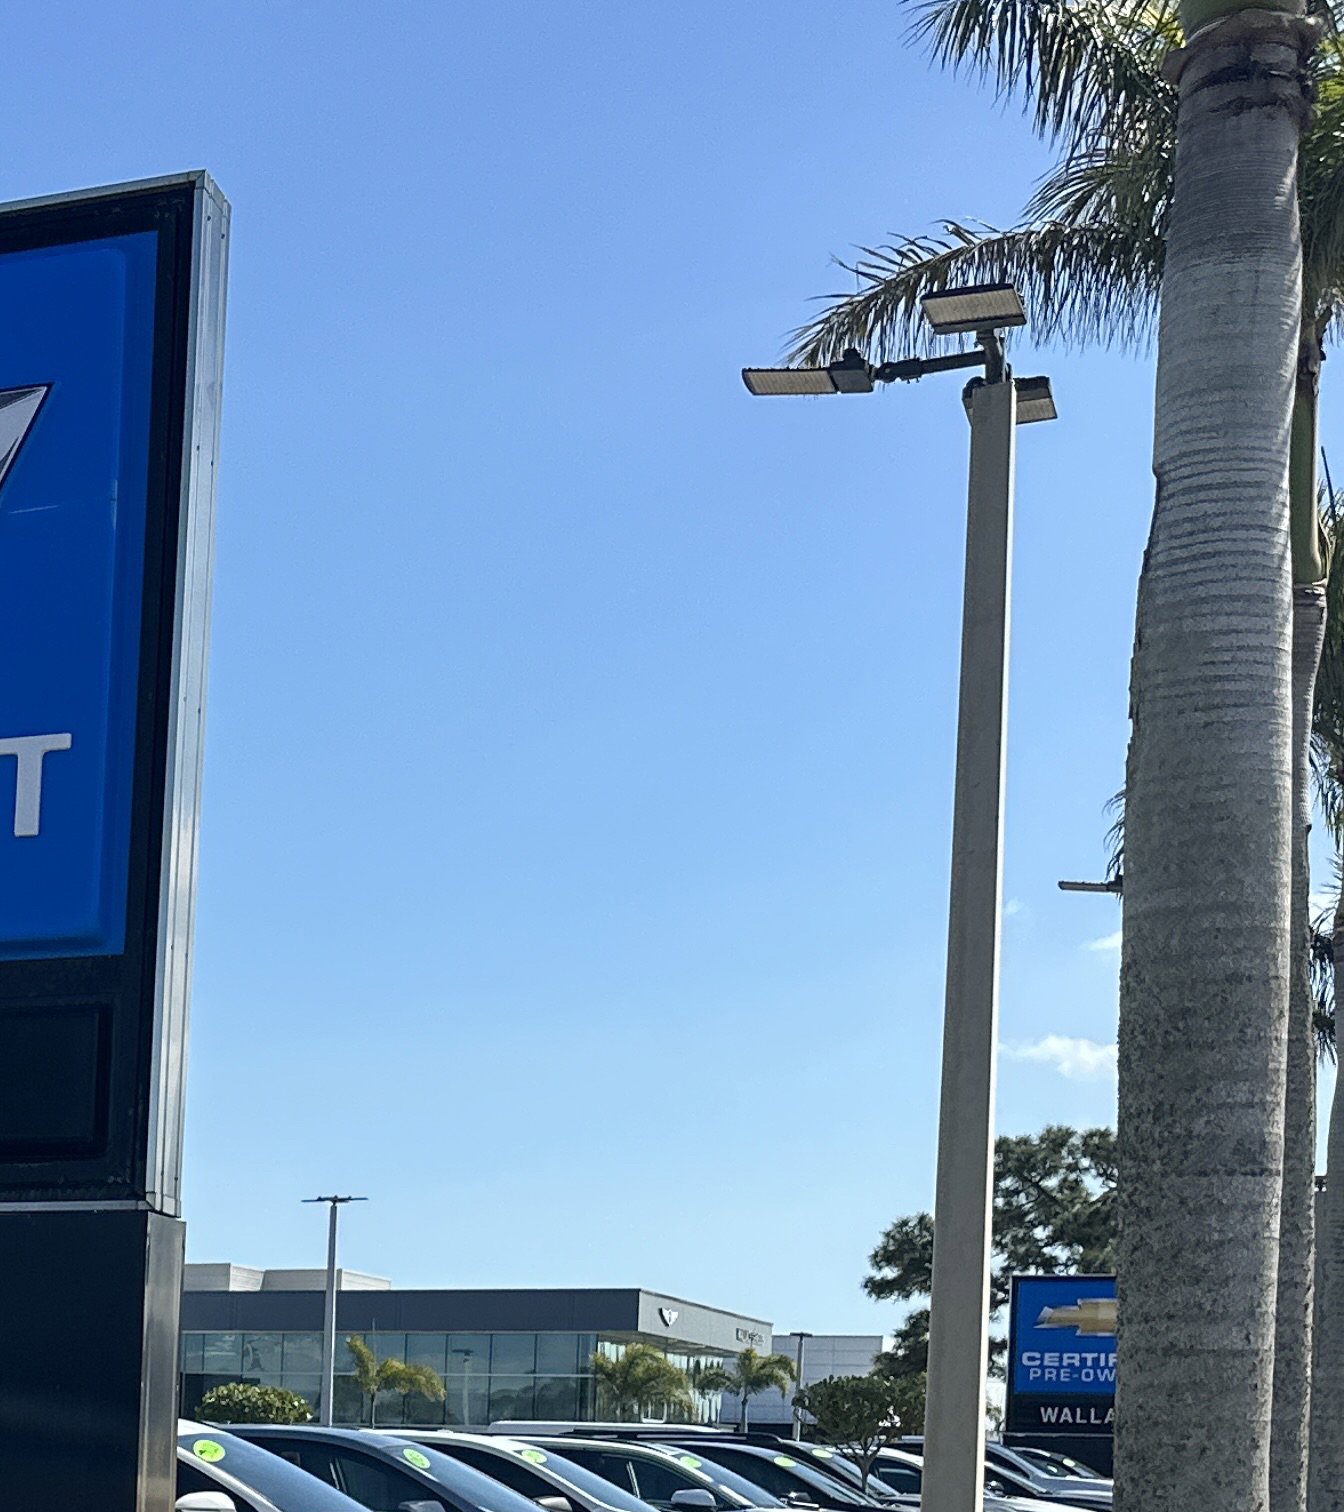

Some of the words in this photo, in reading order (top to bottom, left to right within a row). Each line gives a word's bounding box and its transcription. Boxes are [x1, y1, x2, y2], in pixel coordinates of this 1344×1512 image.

[1021, 1351, 1117, 1368] CERTIF
[1029, 1367, 1116, 1382] PRE-OW
[1040, 1406, 1115, 1424] WALLA
